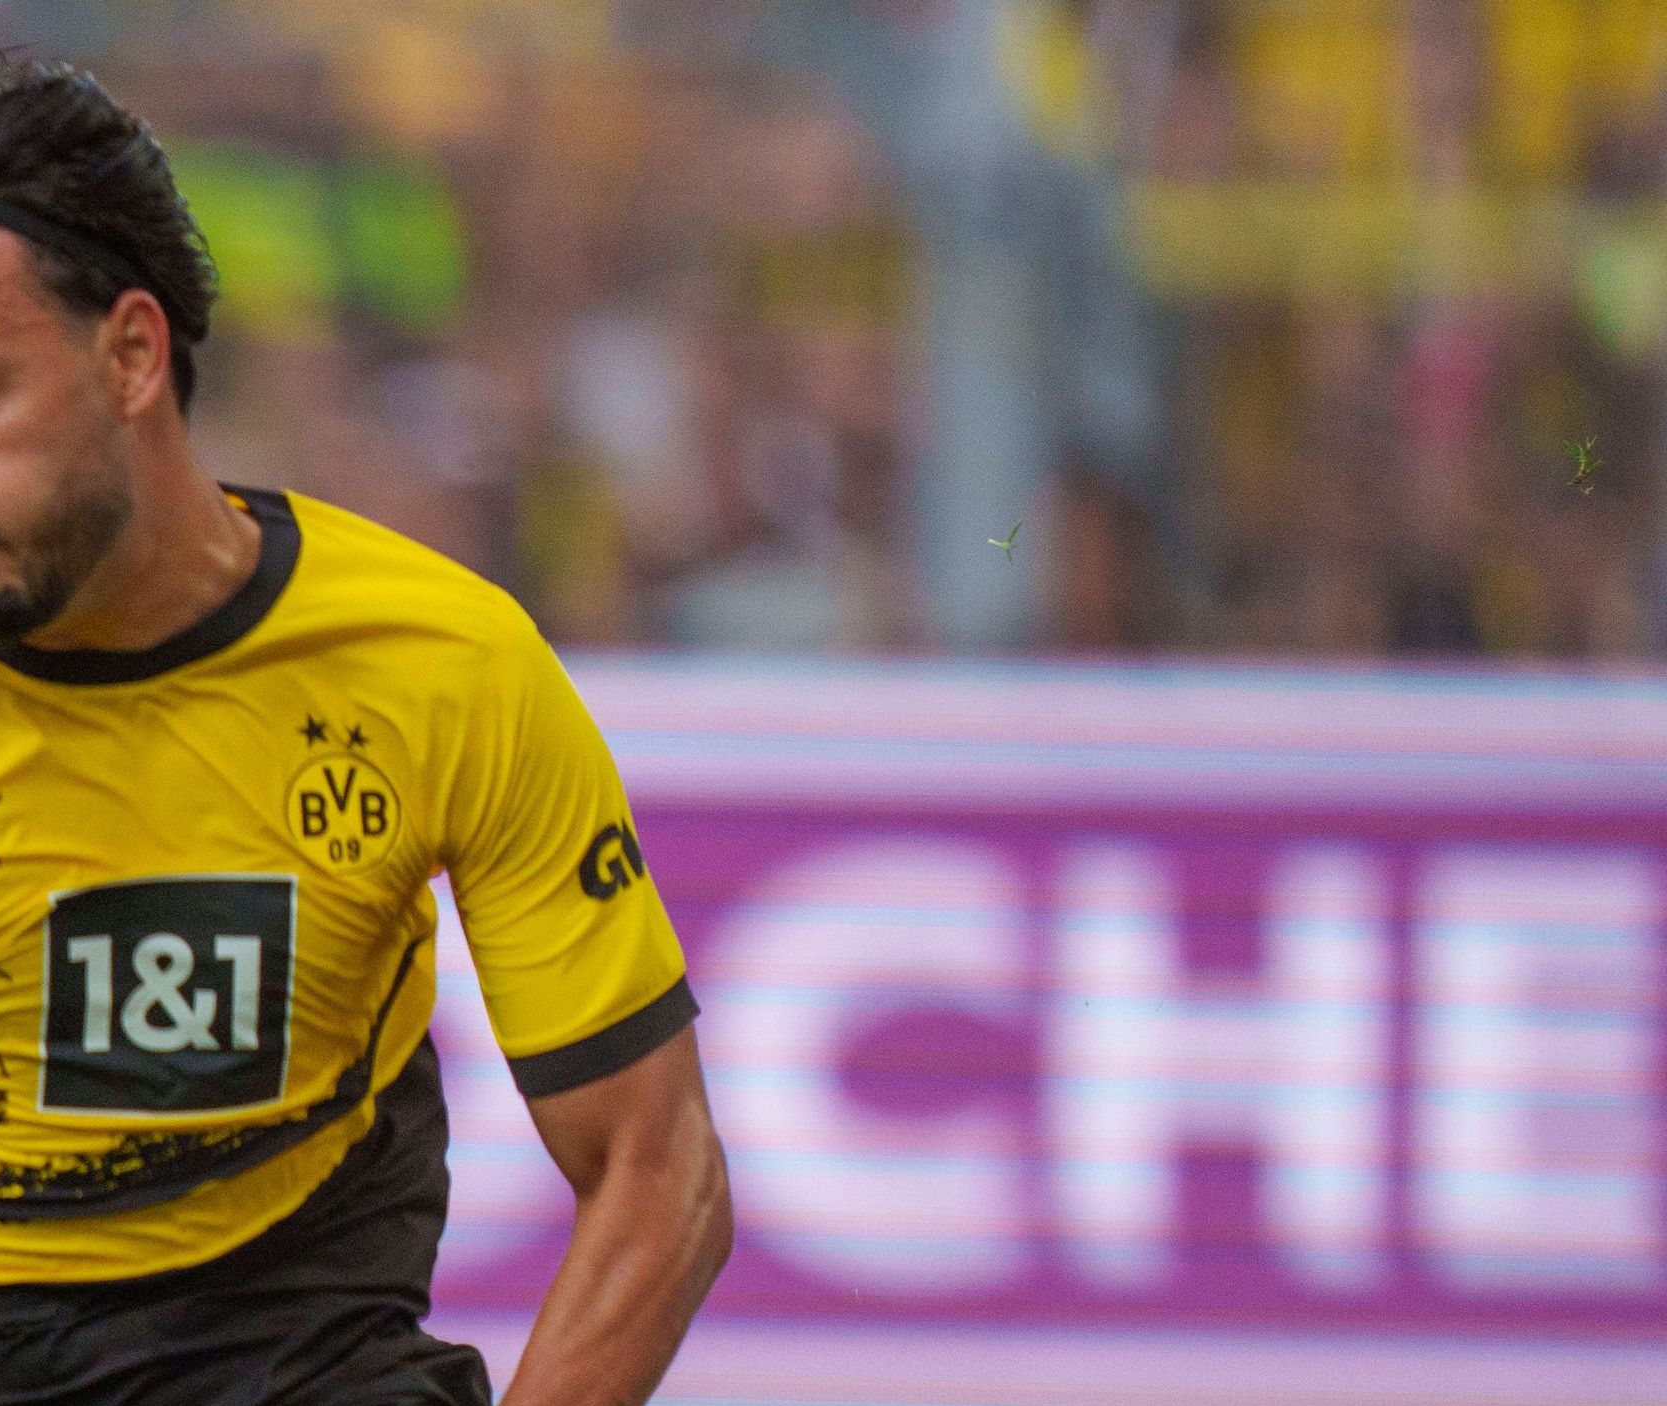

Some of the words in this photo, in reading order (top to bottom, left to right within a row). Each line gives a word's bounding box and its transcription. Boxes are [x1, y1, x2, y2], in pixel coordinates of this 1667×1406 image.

[300, 766, 389, 838] BVB
[328, 836, 361, 863] 09
[67, 931, 263, 1053] 1&1
